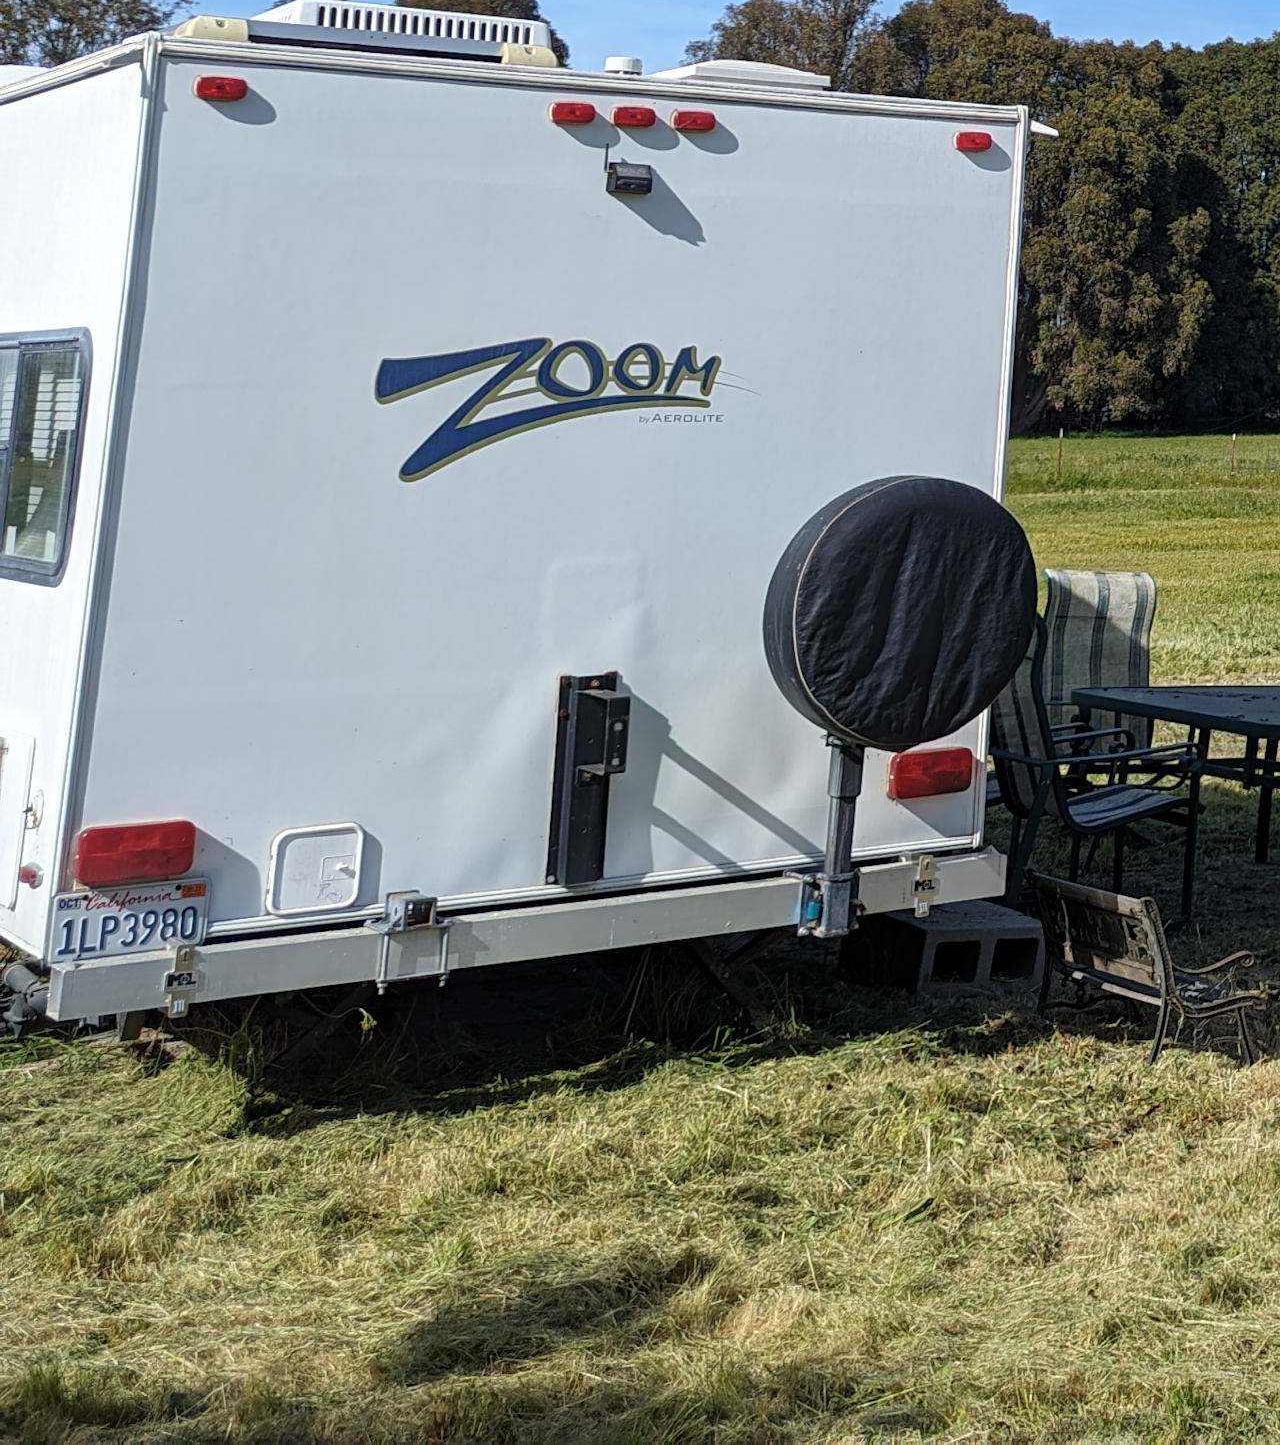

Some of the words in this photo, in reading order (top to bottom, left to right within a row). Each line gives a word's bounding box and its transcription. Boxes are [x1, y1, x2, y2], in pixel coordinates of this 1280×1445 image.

[375, 337, 722, 482] ZOOM
[639, 416, 651, 424] by
[651, 413, 724, 423] AEROLITE
[59, 899, 79, 909] OCT
[85, 891, 182, 912] California
[57, 906, 198, 956] 1LP3980
